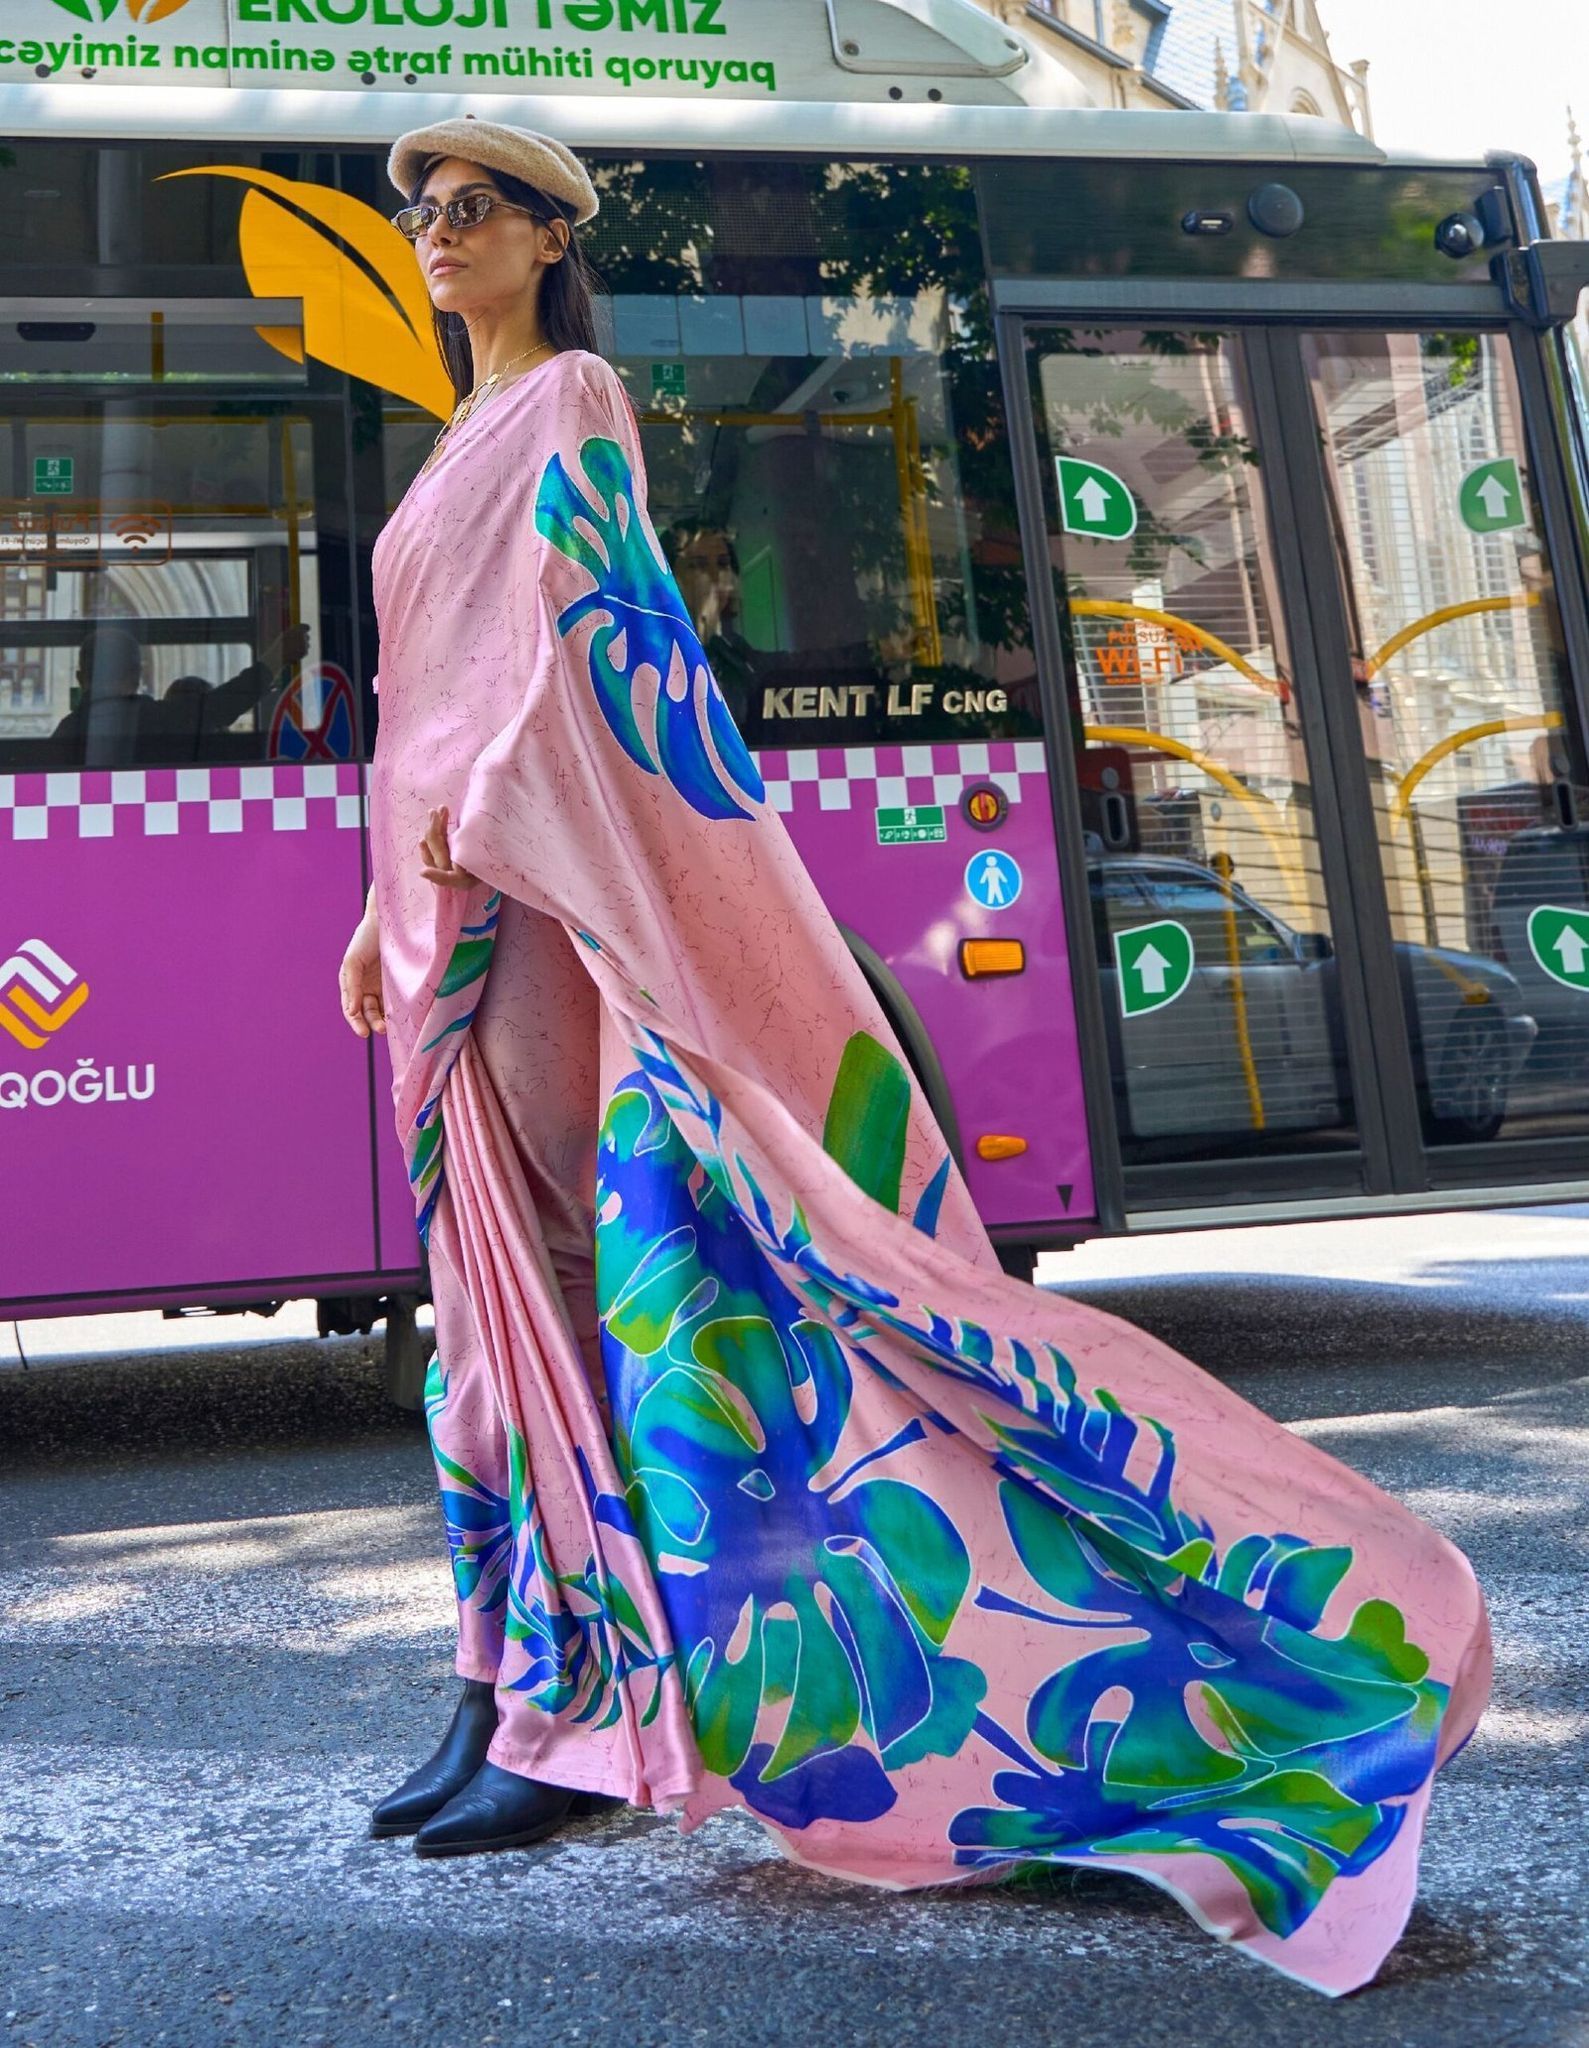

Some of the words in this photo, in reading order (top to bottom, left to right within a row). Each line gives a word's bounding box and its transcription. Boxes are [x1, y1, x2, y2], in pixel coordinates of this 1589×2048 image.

[0, 32, 161, 73] cəyimiz
[173, 38, 336, 73] naminə
[346, 44, 452, 76] ətraf
[461, 46, 594, 79] mühiti
[603, 54, 777, 92] qoruyaq
[762, 684, 876, 720] KENT
[886, 683, 935, 717] LF
[942, 688, 1009, 714] CNG
[0, 1057, 156, 1109] QOĞLU
